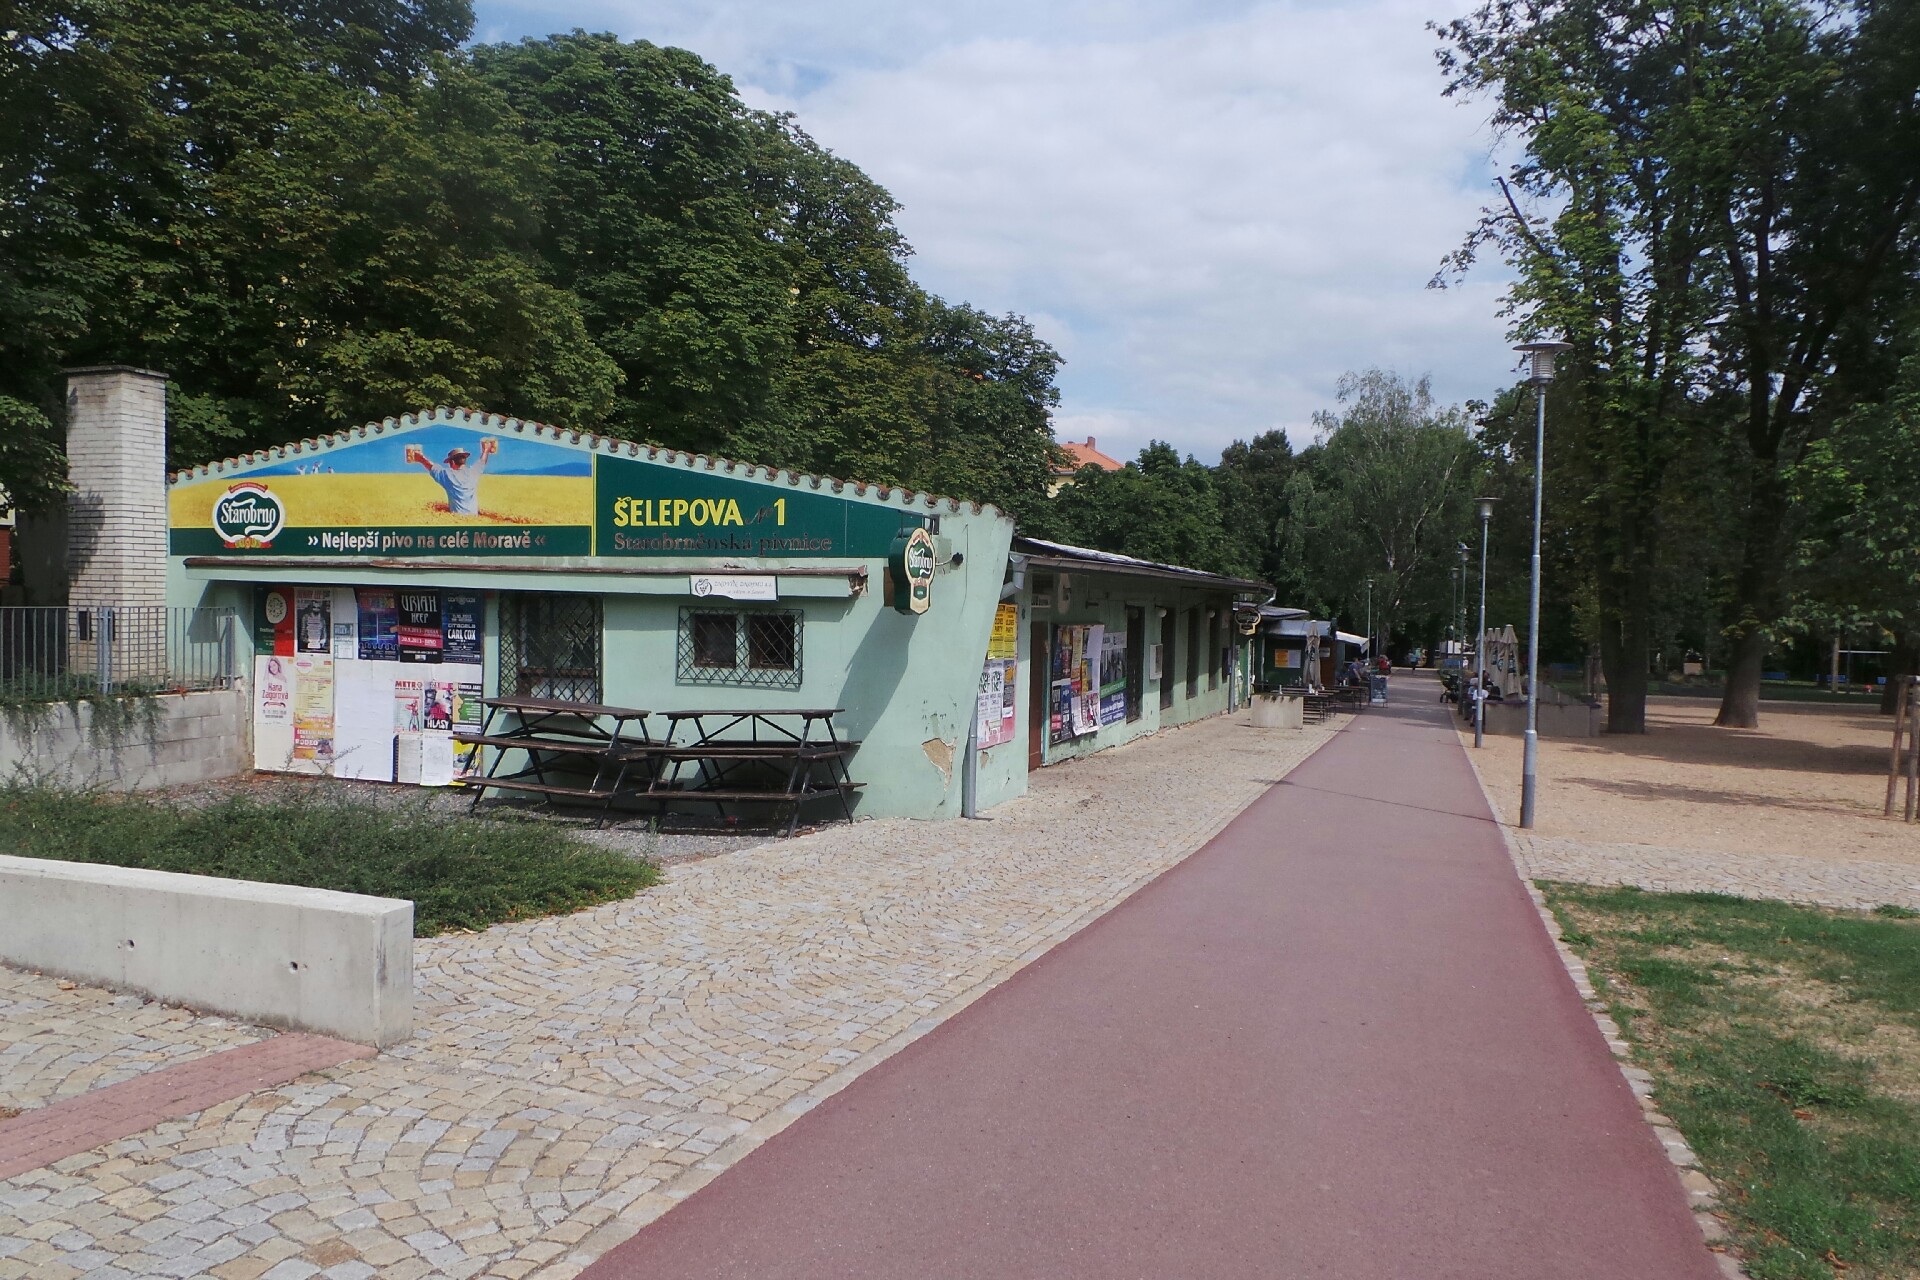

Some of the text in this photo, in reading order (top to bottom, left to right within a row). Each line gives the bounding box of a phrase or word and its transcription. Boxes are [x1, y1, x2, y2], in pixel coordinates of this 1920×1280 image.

[220, 498, 277, 535] Starobrno
[613, 496, 744, 527] ŠELEPOVA
[773, 498, 785, 526] 1
[322, 531, 380, 552] Nejlepší
[382, 531, 414, 552] pivo
[417, 535, 436, 548] na
[439, 530, 470, 549] celé
[473, 530, 531, 549] Moravě
[614, 532, 832, 556] Starobrněnská pivnice
[401, 594, 438, 613] URIAH
[411, 612, 429, 624] HEEP
[447, 629, 476, 641] CARL COX
